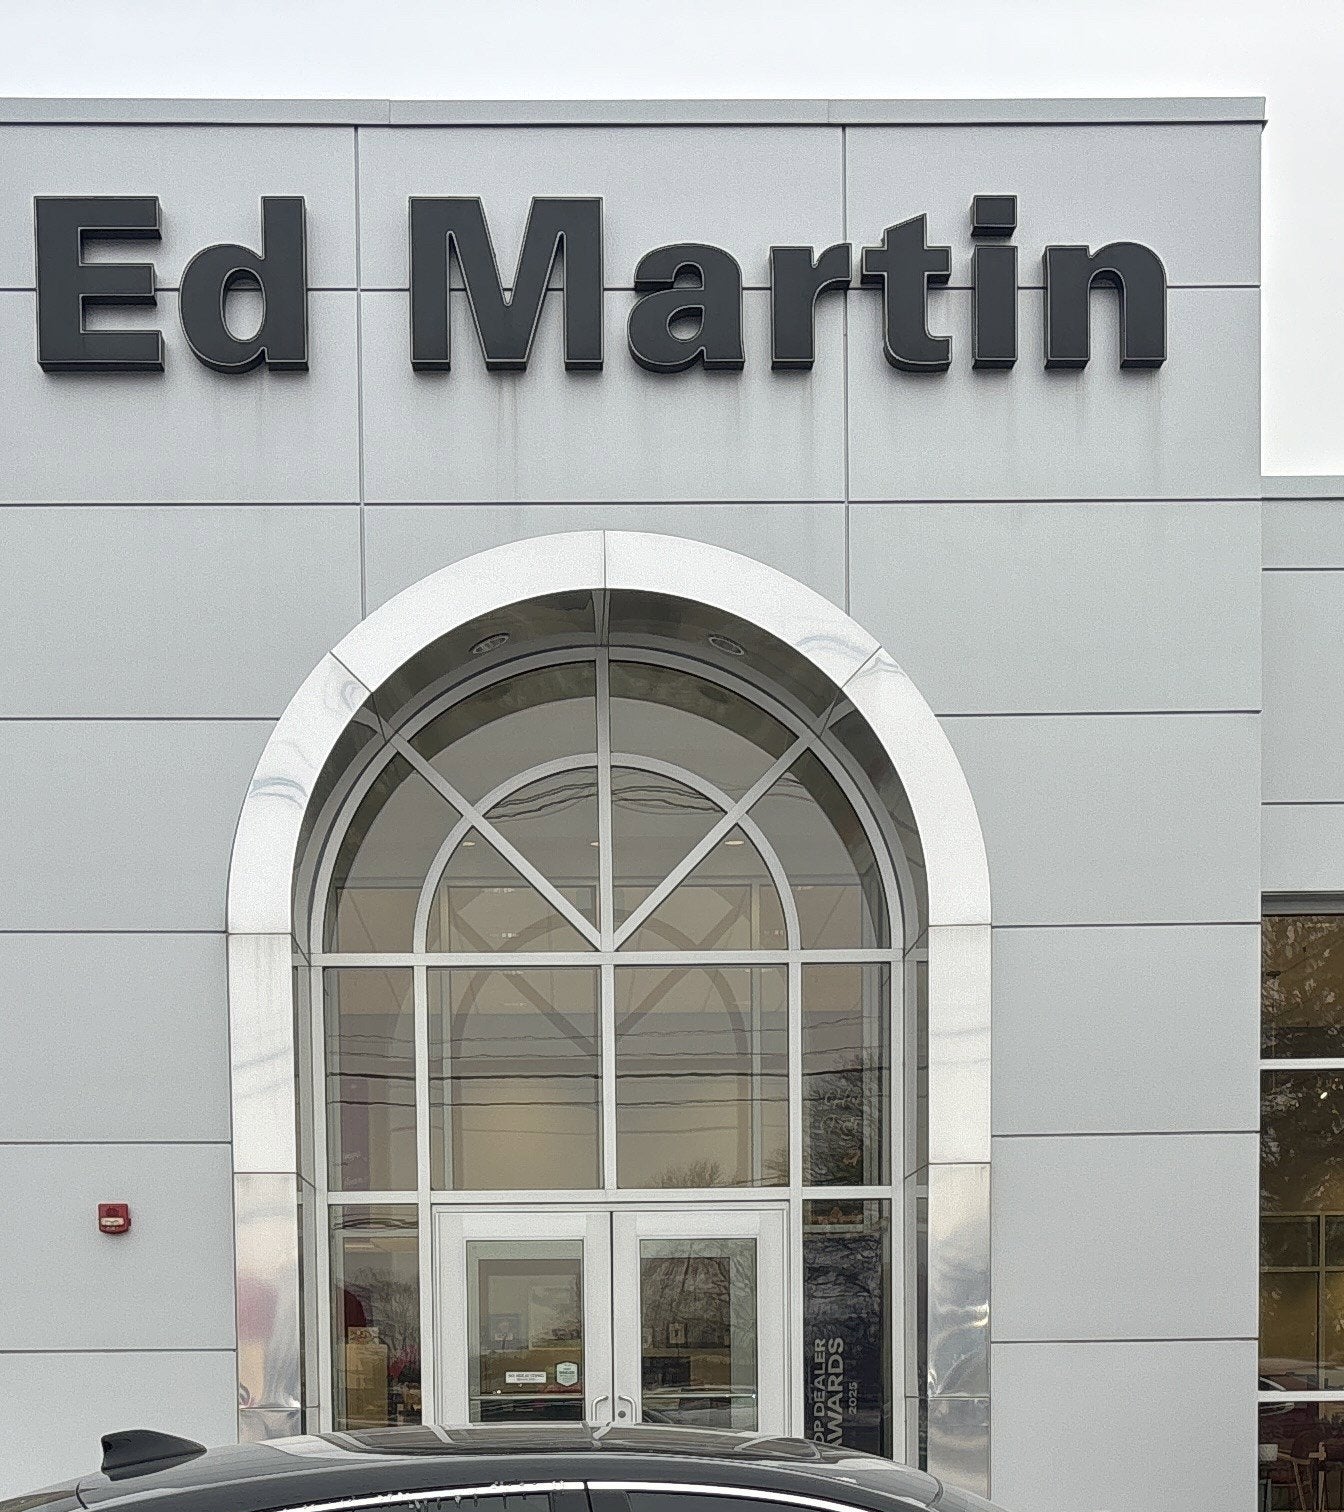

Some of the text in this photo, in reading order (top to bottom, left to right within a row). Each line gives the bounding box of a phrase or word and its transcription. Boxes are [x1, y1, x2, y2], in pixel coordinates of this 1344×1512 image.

[33, 194, 1169, 374] Ed Martin
[813, 1338, 826, 1443] OP DEALER
[848, 1381, 858, 1415] 2025
